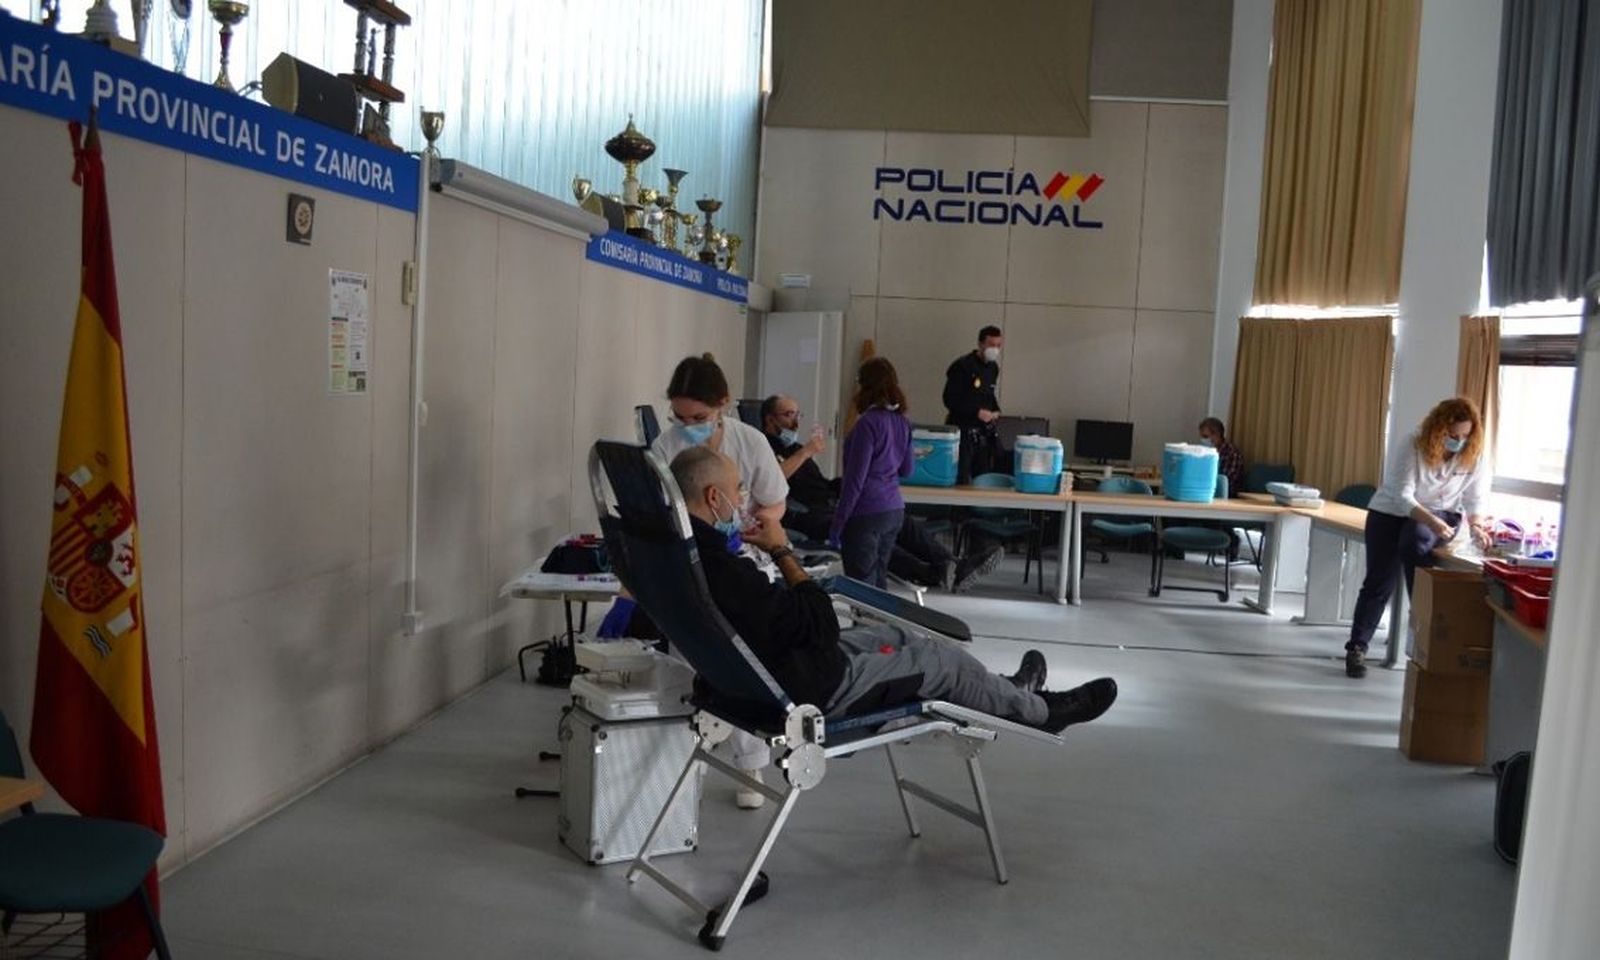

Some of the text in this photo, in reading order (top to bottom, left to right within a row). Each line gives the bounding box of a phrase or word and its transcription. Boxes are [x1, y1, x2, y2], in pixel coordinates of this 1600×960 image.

[0, 44, 395, 194] RÍA PROVINCIAL DE ZAMORA
[874, 167, 1041, 196] POLICÍA
[873, 198, 1104, 229] NACIONAL
[674, 262, 683, 279] DE
